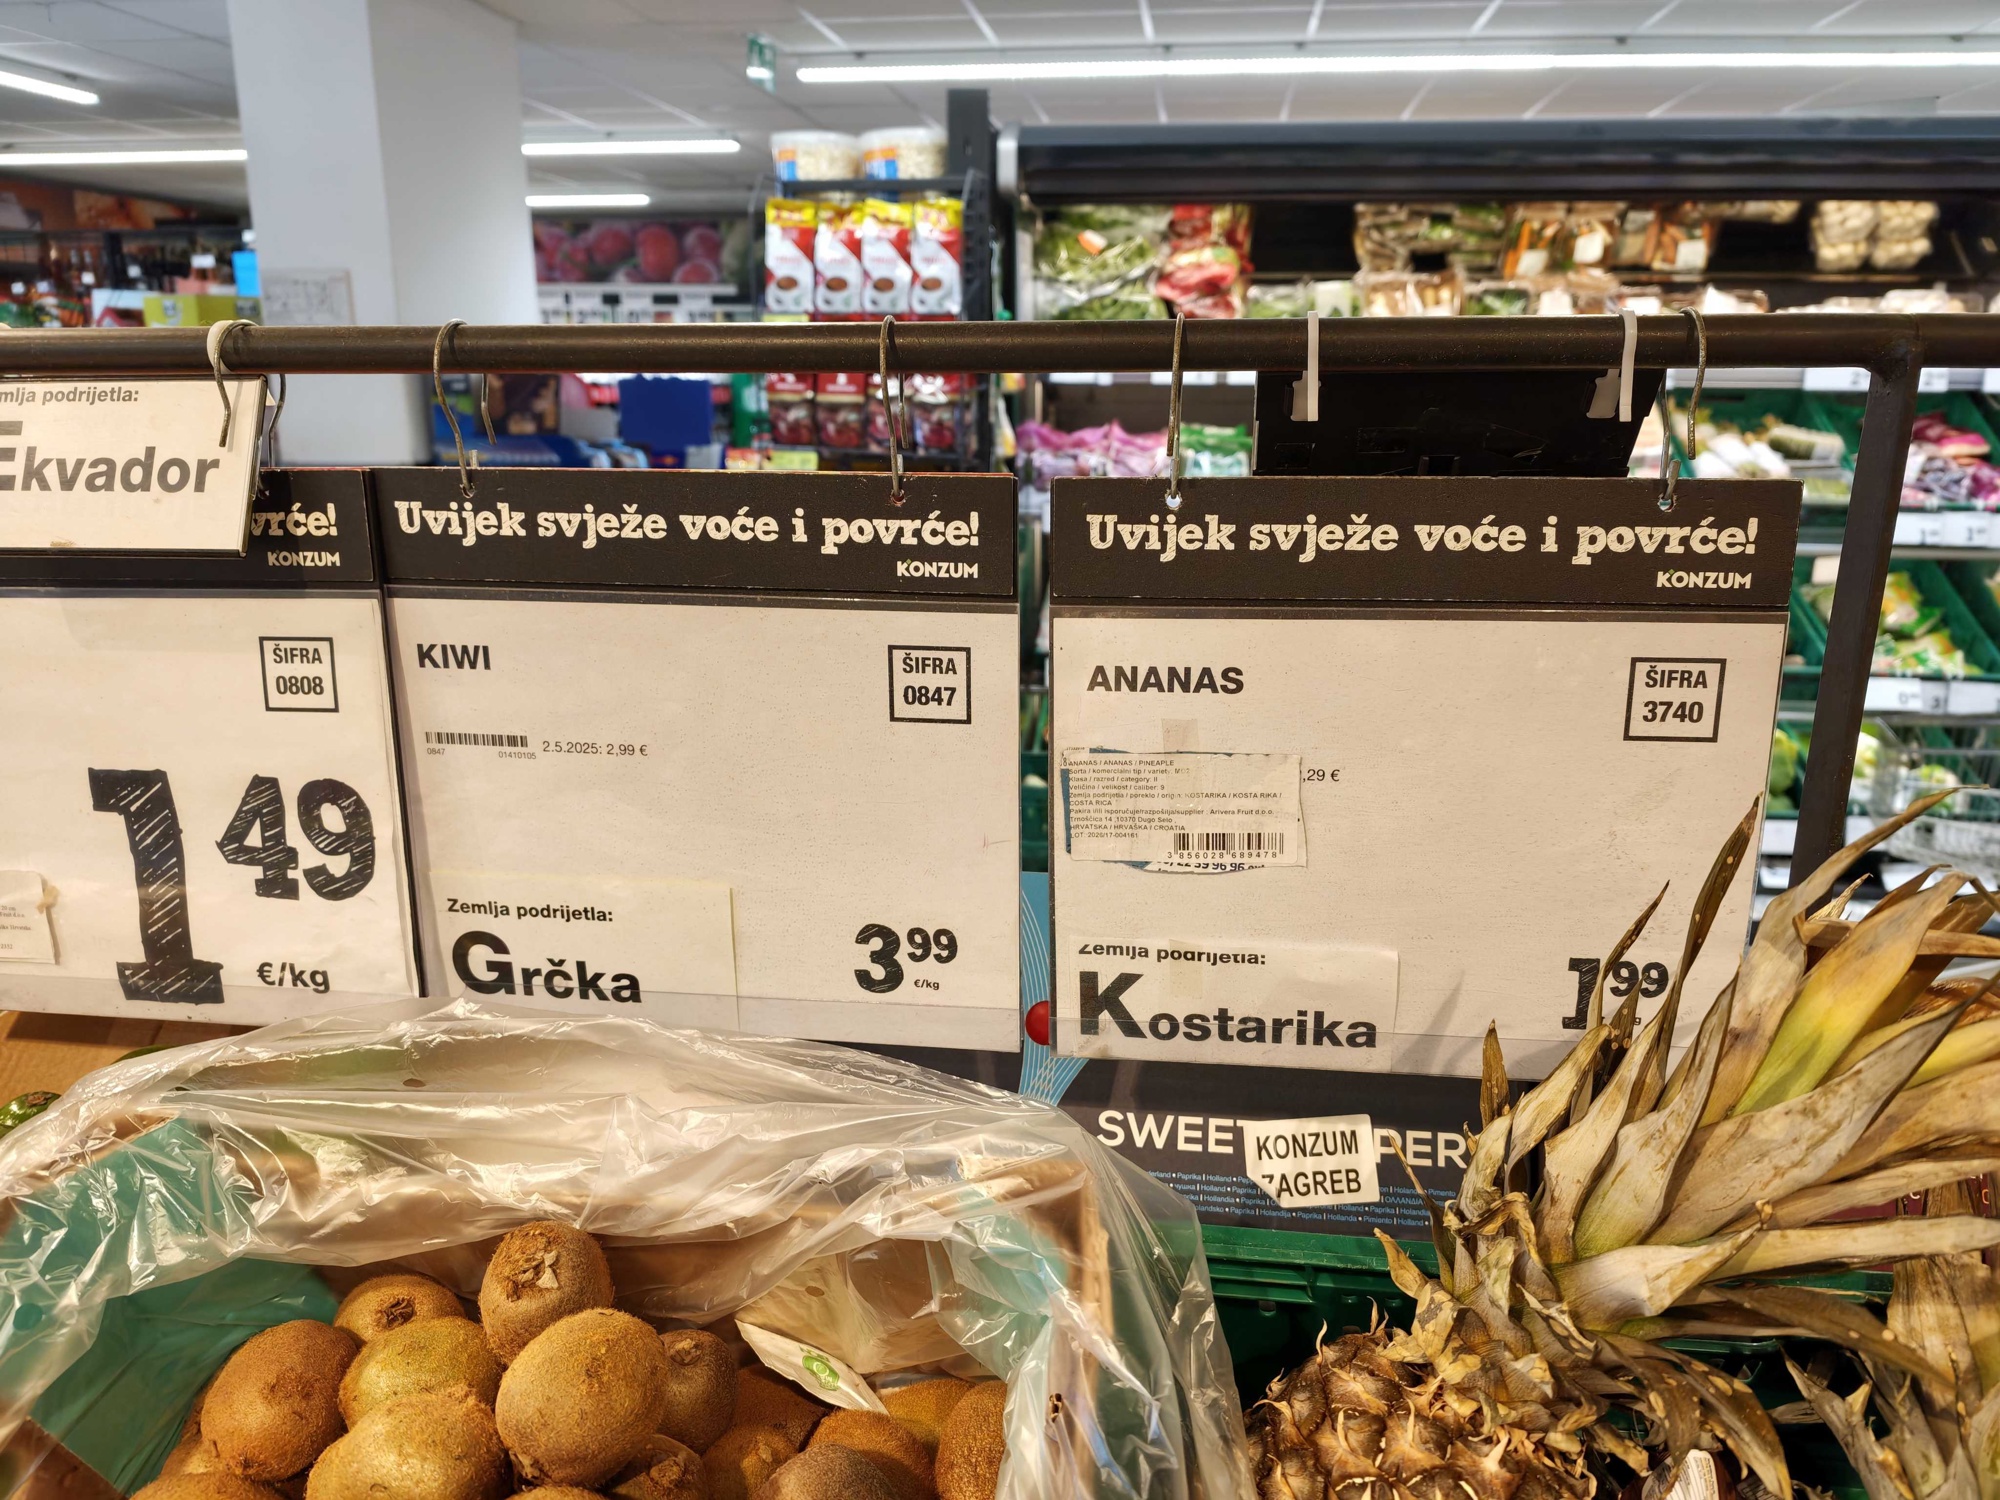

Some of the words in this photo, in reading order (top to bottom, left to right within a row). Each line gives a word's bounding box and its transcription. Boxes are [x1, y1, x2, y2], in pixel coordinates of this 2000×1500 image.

[0, 385, 39, 407] mlja
[42, 385, 140, 406] podrijetla:
[251, 502, 338, 537] vrće!
[394, 501, 526, 547] Uvijek
[537, 504, 668, 549] svježe
[679, 507, 779, 542] voće
[792, 508, 807, 542] i
[820, 510, 980, 554] povrće!
[1086, 513, 1235, 562] Uvijek
[1248, 514, 1400, 562] svježe
[1414, 515, 1526, 552] voće
[1541, 516, 1558, 552] i
[1572, 516, 1759, 565] povrće!
[268, 552, 340, 566] KONZUM
[897, 559, 978, 578] KONZUM
[1657, 569, 1751, 588] KONZUM
[273, 643, 323, 665] ŠIFRA
[417, 644, 490, 670] KIWI
[902, 653, 958, 675] ŠIFRA
[276, 676, 324, 695] 0808
[1087, 666, 1244, 694] ANANAS
[1645, 665, 1709, 690] ŠIFRA
[903, 685, 956, 706] 0847
[1643, 701, 1703, 723] 3740
[424, 744, 447, 758] 0847
[543, 741, 601, 754] 2.5.2025:
[607, 744, 635, 756] 2,99
[640, 745, 647, 756] €
[1103, 760, 1134, 768] ANANAS
[1138, 760, 1175, 768] PINEAPLE
[1133, 768, 1143, 777] tip
[1093, 776, 1116, 784] razred
[1299, 768, 1327, 784] ,29
[1331, 769, 1339, 781] €
[1101, 784, 1129, 792] velikost
[1129, 793, 1157, 801] poreklo
[1137, 816, 1156, 825] Dugo
[1157, 816, 1173, 824] Selo
[1153, 825, 1186, 833] CROATIA
[1232, 850, 1280, 858] 689478
[447, 898, 510, 918] Zemlja
[517, 905, 612, 922] podrijetla:
[452, 931, 642, 1003] Grčka
[257, 962, 330, 994] €/kg
[914, 979, 939, 990] €/kg
[1080, 971, 1376, 1048] Kostarika
[1097, 1110, 1254, 1152] SWEE
[1257, 1130, 1358, 1160] KONZUM
[1177, 1172, 1201, 1180] Paprika
[1206, 1174, 1232, 1182] Holland
[1200, 1184, 1226, 1192] Holland
[1232, 1186, 1257, 1194] Paprika
[1240, 1197, 1266, 1205] Paprika
[1338, 1203, 1364, 1212] Holland
[1370, 1205, 1395, 1214] Paprika
[1195, 1205, 1224, 1213] olandsko
[1230, 1207, 1255, 1216] Paprika
[1260, 1209, 1291, 1218] Holandija
[1297, 1211, 1322, 1220] Paprika
[1327, 1213, 1357, 1222] Hollanda
[1363, 1215, 1392, 1224] Pimiento
[1397, 1217, 1424, 1226] Holland
